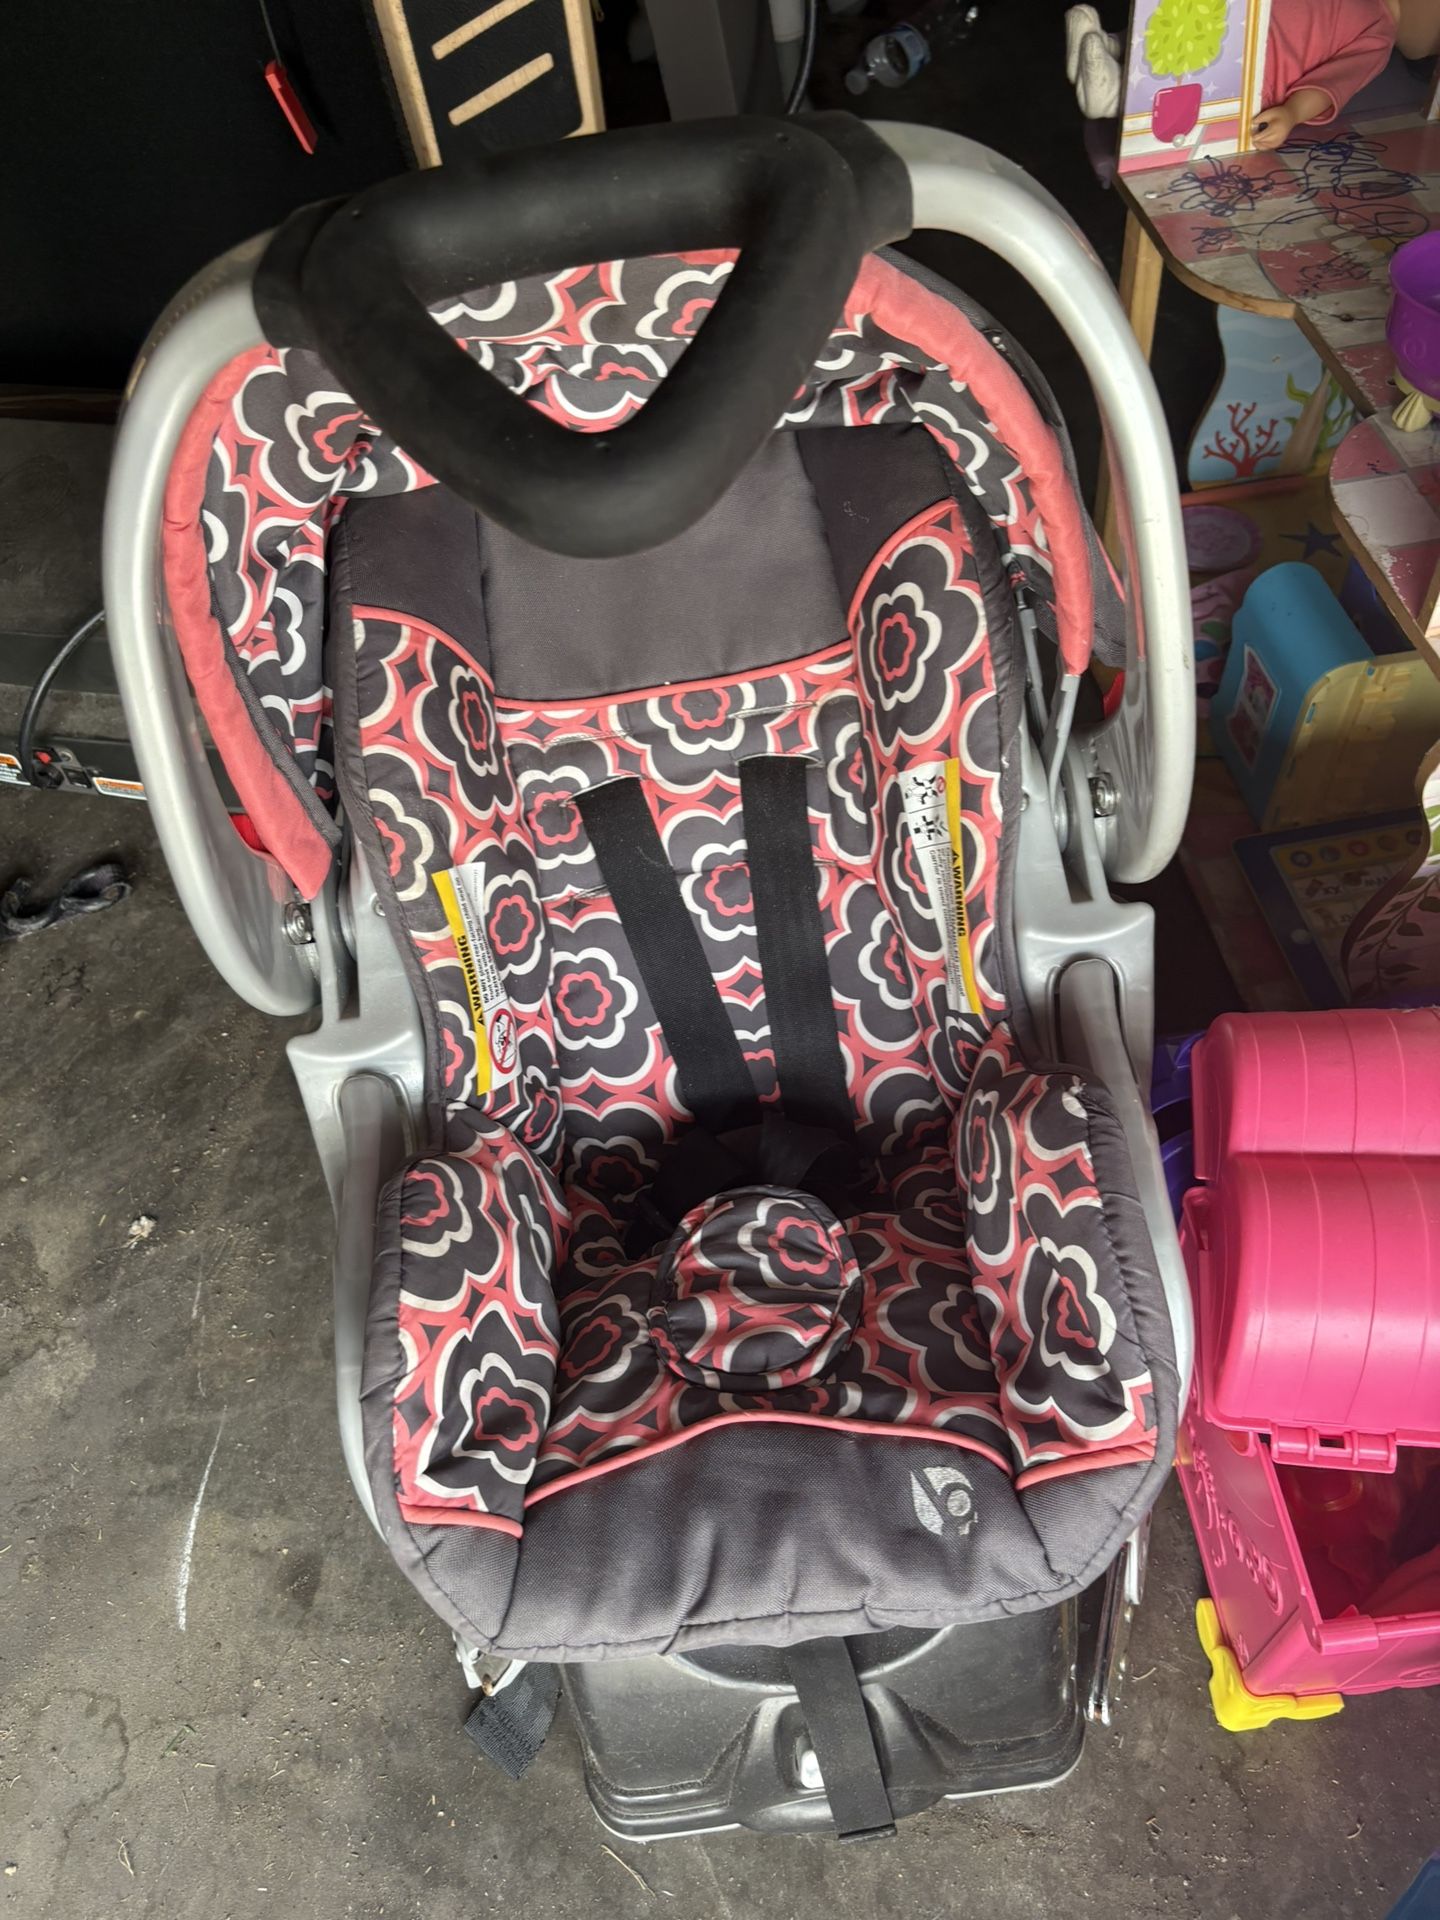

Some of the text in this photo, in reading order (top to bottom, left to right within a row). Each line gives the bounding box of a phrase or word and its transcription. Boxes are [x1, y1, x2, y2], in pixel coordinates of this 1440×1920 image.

[456, 886, 465, 902] seat
[952, 865, 966, 937] WARNING
[460, 902, 471, 920] child
[465, 919, 480, 957] rear-facing
[456, 934, 483, 1011] WARNING
[475, 957, 485, 977] place
[483, 968, 491, 983] seat
[479, 978, 487, 992] NOT
[486, 983, 495, 1001] front
[482, 993, 490, 1004] DO
